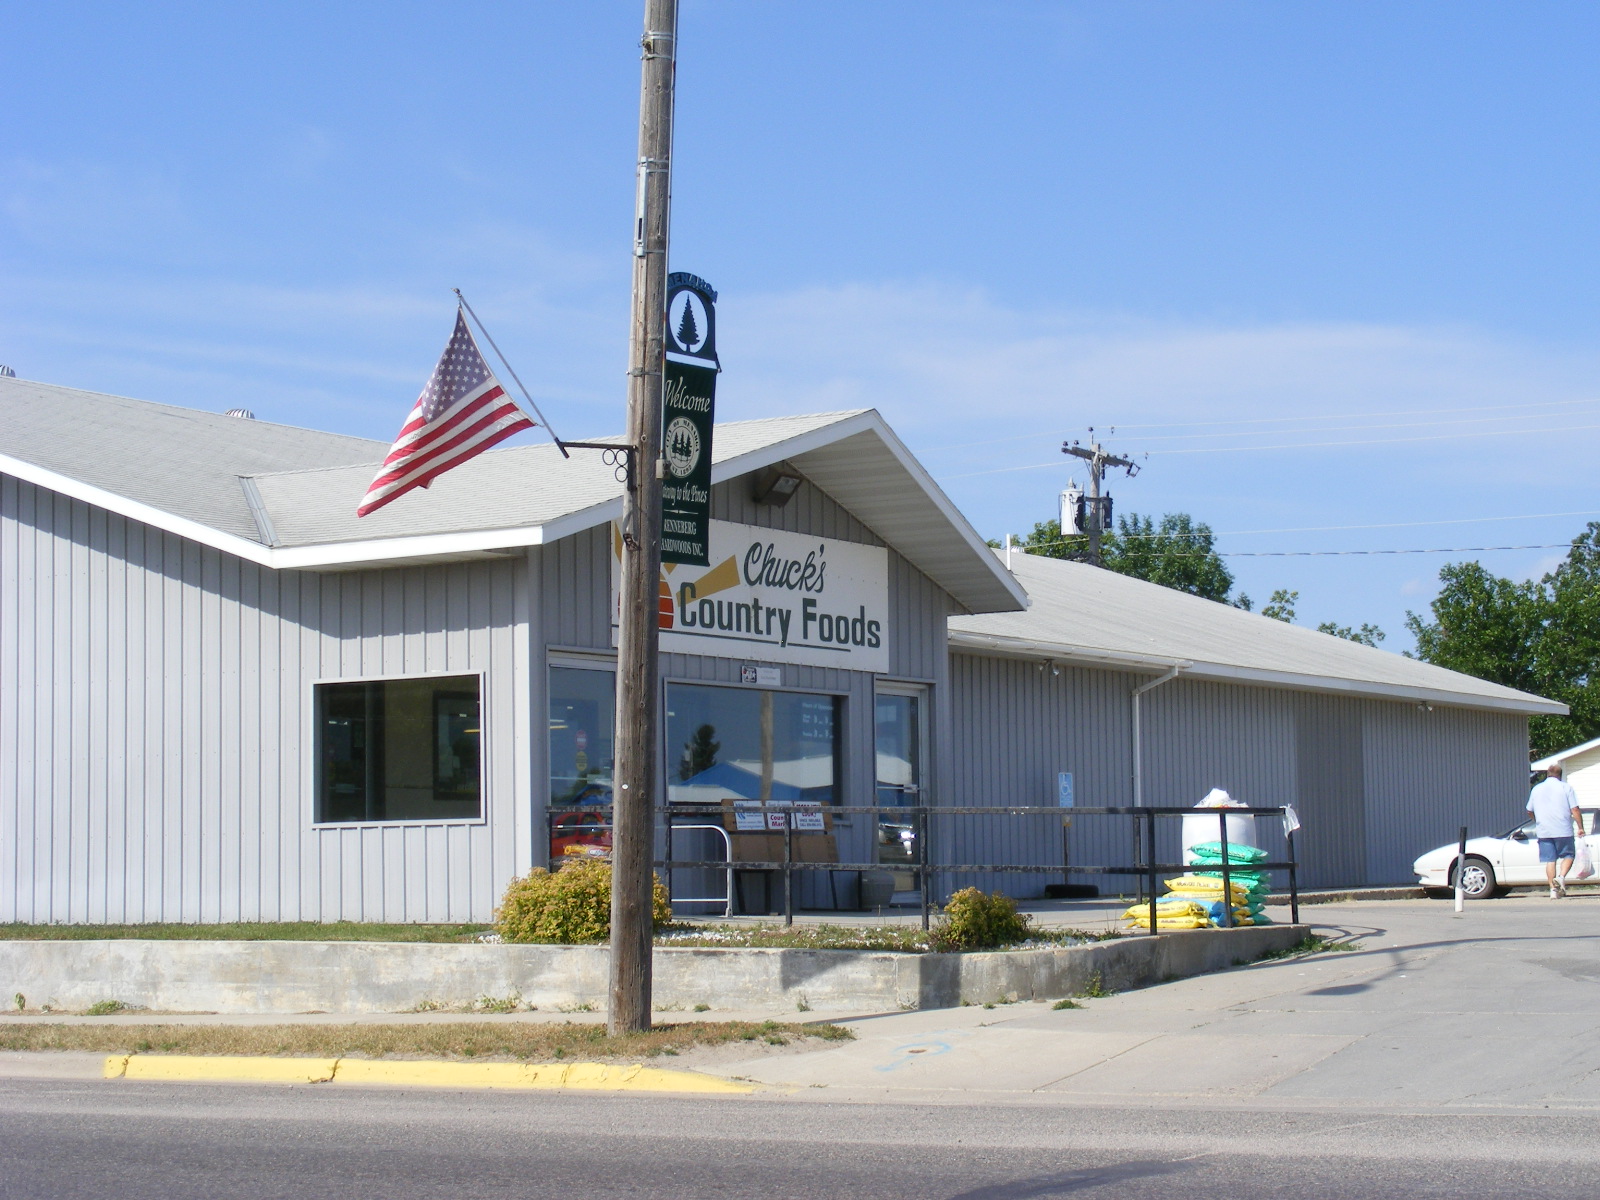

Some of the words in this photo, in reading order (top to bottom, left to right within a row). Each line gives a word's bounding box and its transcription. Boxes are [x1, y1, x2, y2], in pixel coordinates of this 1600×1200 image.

[665, 376, 711, 412] Welcome
[692, 542, 704, 556] INC.
[743, 541, 827, 593] Chuck's
[680, 581, 792, 648] Country
[802, 597, 881, 648] Foods
